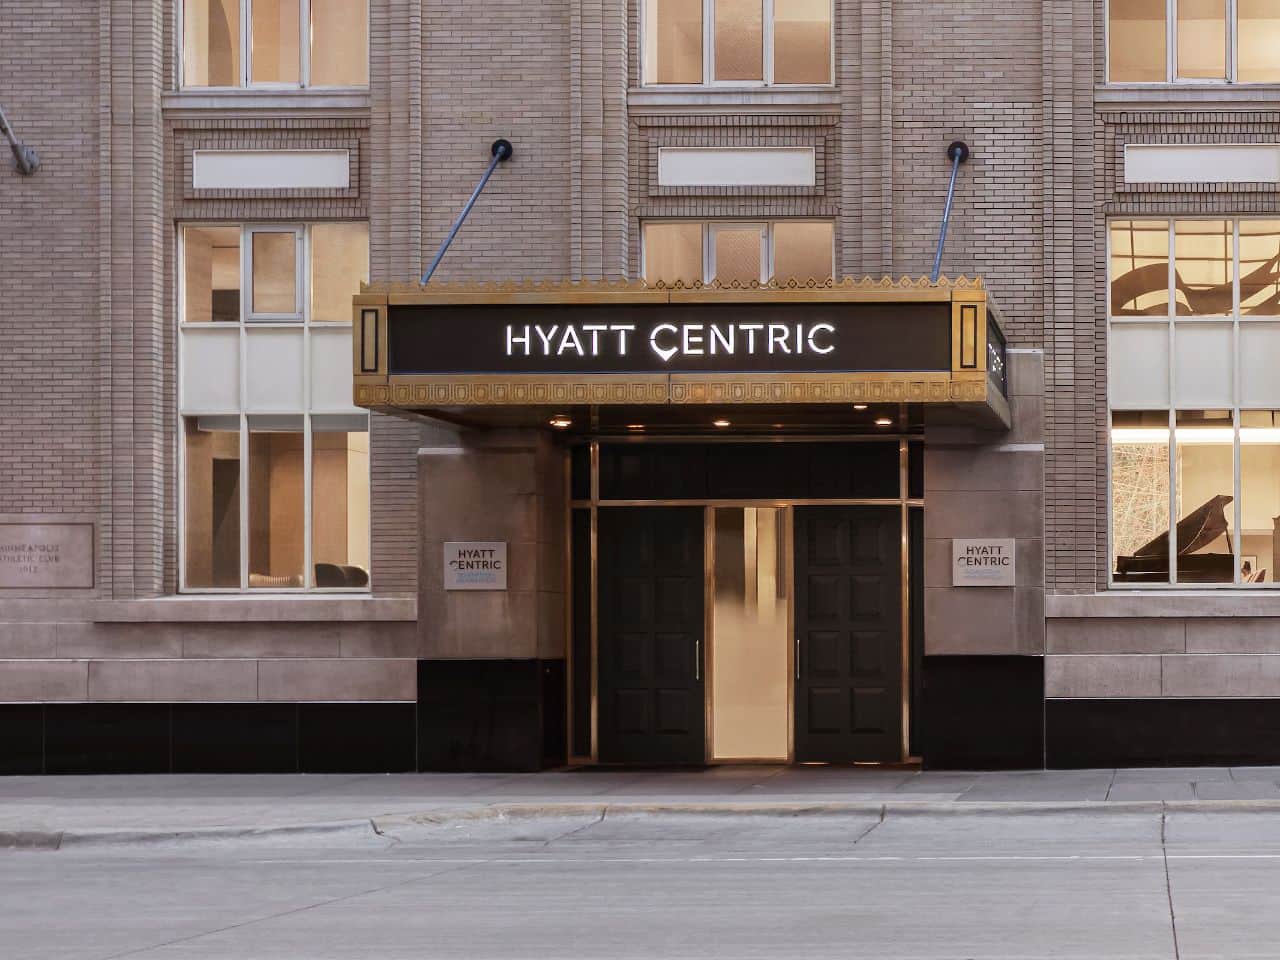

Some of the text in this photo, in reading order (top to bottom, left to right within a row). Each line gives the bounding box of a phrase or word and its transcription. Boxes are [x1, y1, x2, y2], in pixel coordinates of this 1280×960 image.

[506, 323, 836, 361] HYATT CENTRIC
[458, 549, 496, 559] HYATT
[966, 545, 1004, 555] HYATT
[449, 560, 502, 571] CENTRIC
[957, 556, 1010, 567] CENTRIC
